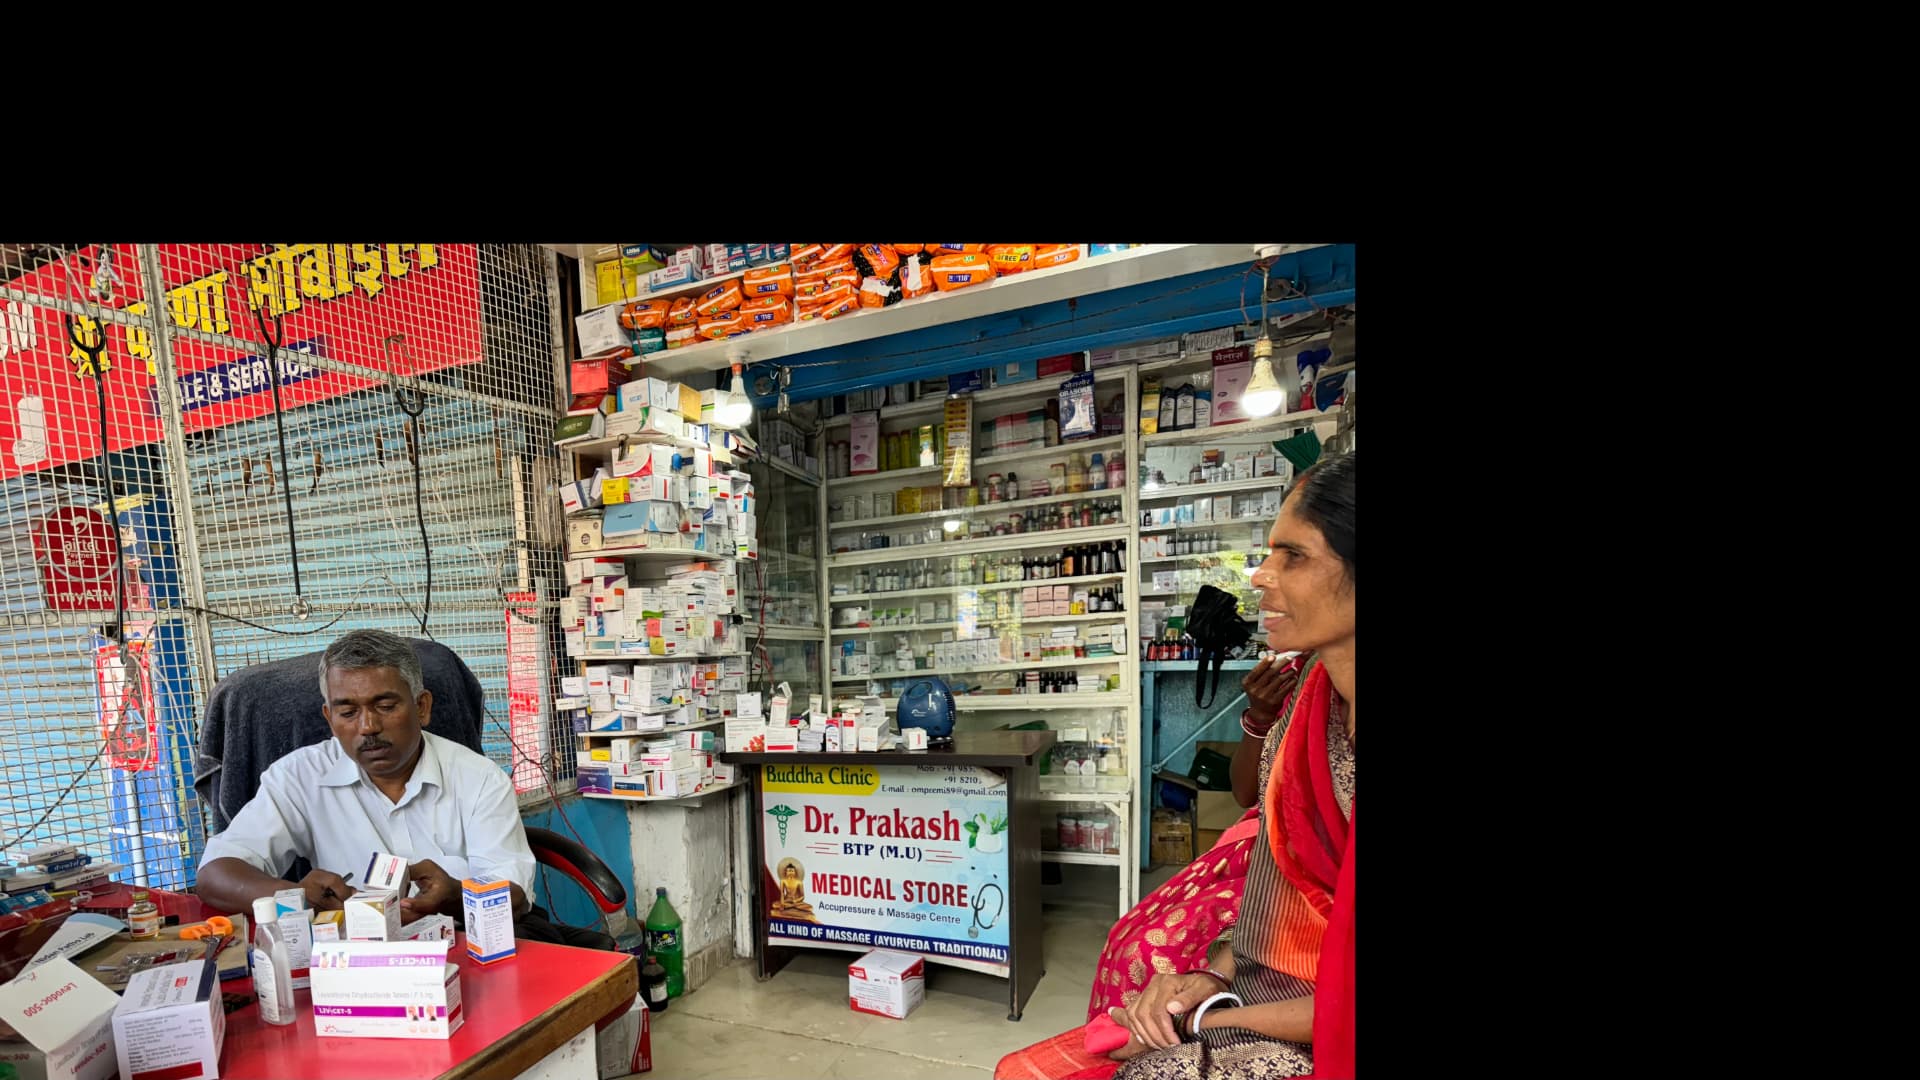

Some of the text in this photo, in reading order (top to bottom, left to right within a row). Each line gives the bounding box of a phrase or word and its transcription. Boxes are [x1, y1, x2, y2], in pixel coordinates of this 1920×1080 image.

[210, 373, 224, 398] &
[64, 537, 100, 552] airtel
[60, 588, 116, 606] myATM
[766, 764, 875, 786] Buddha Clinic
[944, 775, 956, 784] +91
[803, 804, 962, 842] Dr. Prakash
[843, 842, 923, 863] BTP (M.U)
[811, 872, 969, 908] MEDICAL STORE
[818, 900, 961, 925] Accupressure & Massage Centre
[769, 921, 1008, 963] ALL KIND OF MASSAGE (AYURVEDA TRADITIONAL)
[23, 982, 78, 1018] Levodoc-500
